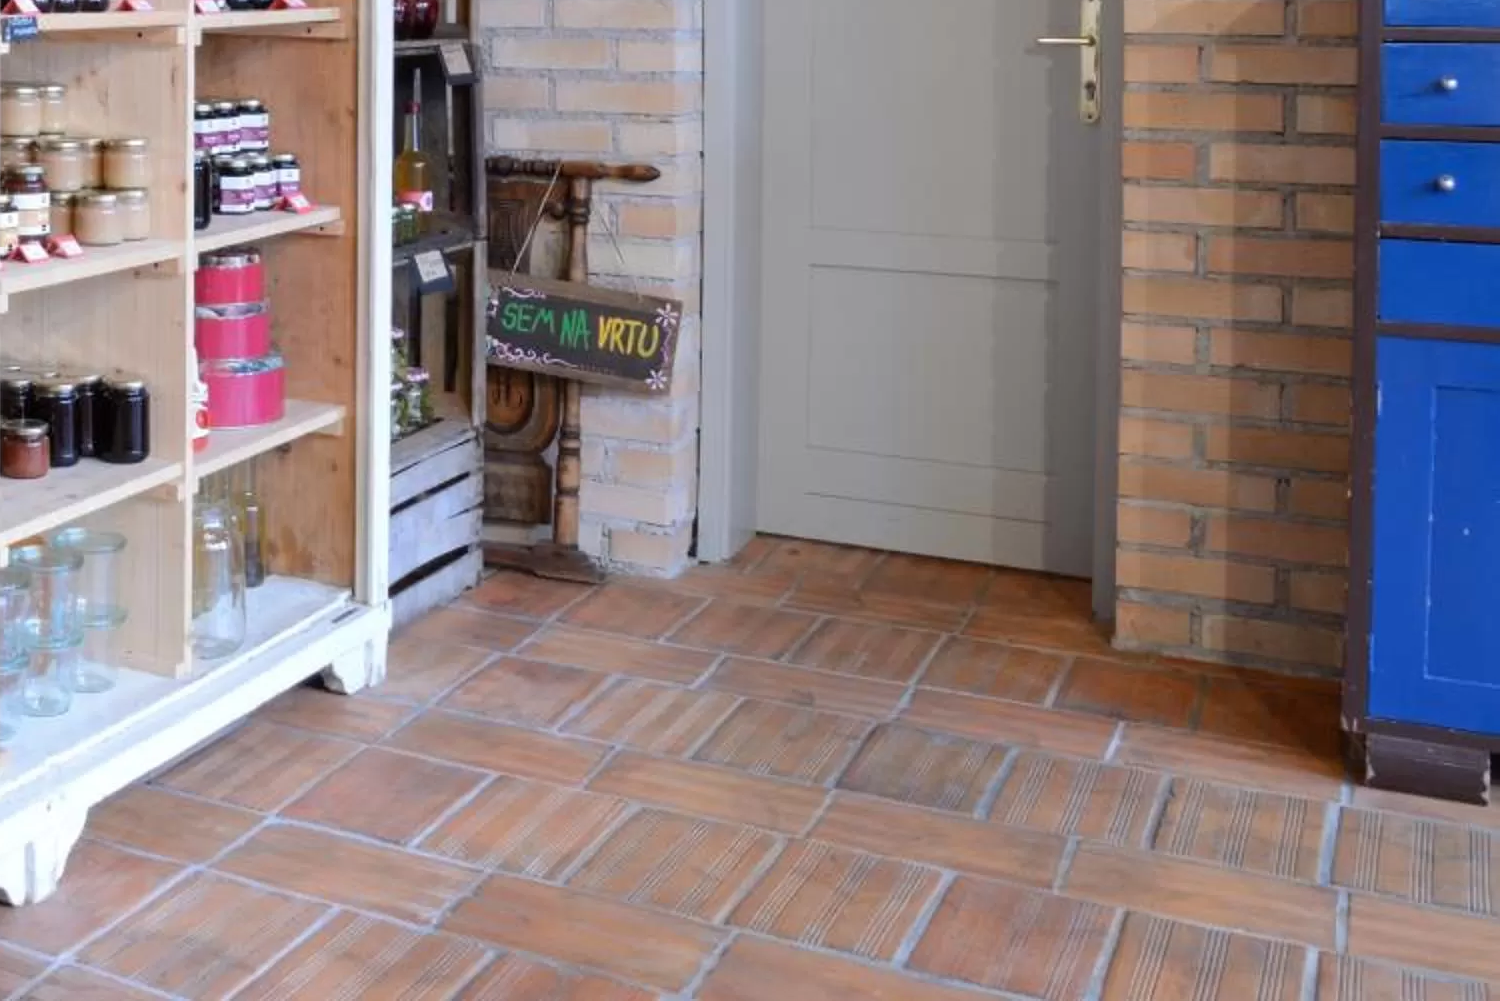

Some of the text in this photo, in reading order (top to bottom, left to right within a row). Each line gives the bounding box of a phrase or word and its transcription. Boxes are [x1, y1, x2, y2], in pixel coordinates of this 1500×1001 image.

[502, 303, 660, 359] SEM NA VRTU
